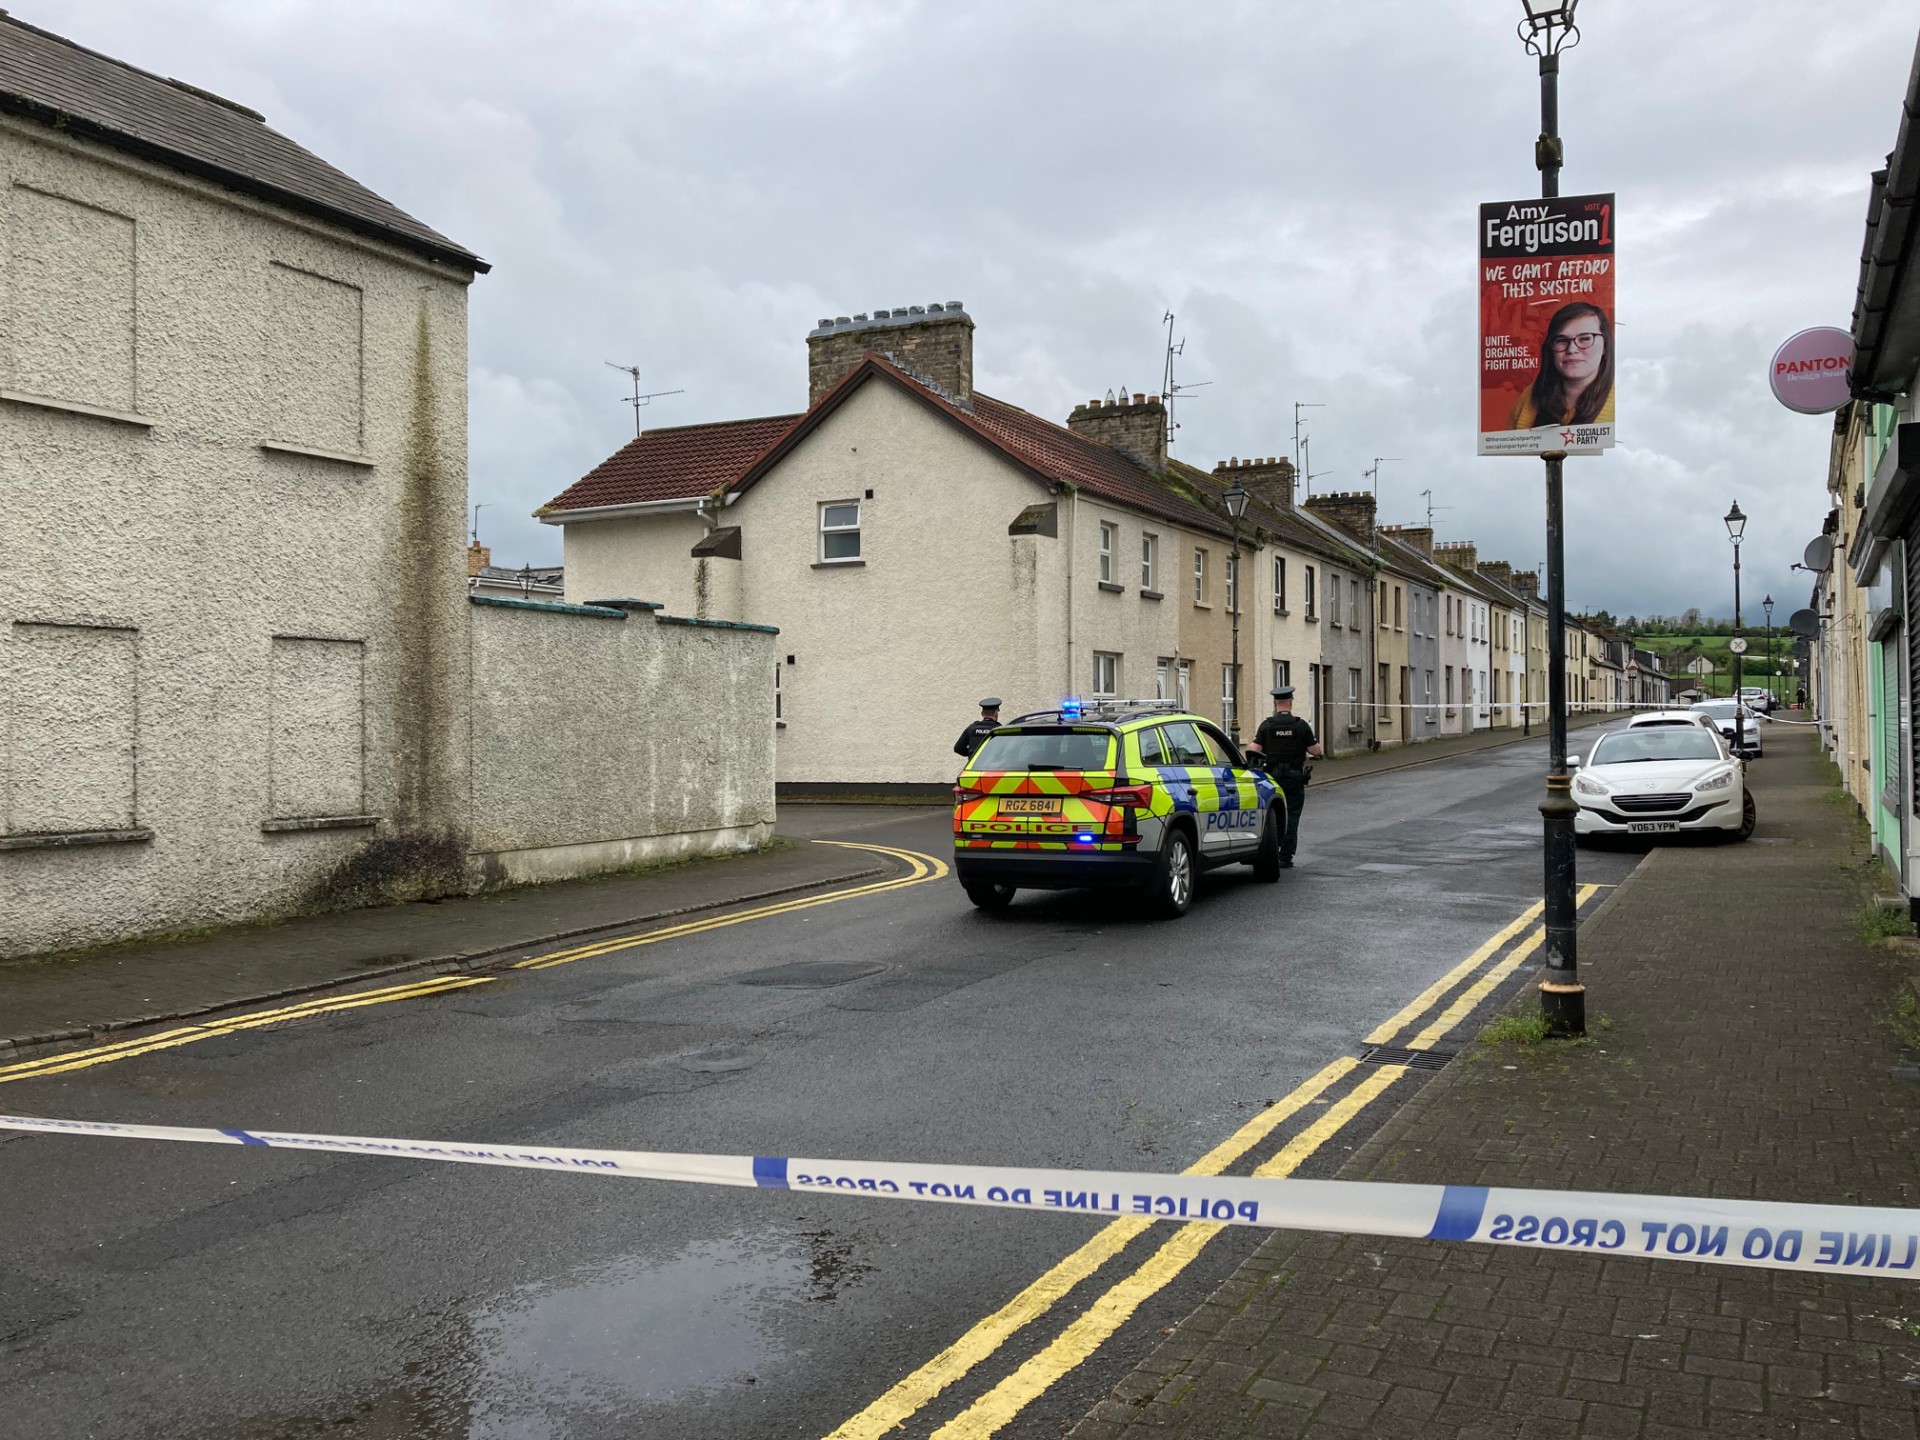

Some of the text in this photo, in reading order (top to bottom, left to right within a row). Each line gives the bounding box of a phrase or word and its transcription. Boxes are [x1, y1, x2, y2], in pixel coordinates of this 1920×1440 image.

[1506, 204, 1566, 223] Amy
[1599, 203, 1612, 246] 1
[1486, 218, 1598, 253] Ferguson
[1485, 265, 1507, 281] WE
[1558, 258, 1610, 278] AFFORD
[1502, 278, 1593, 298] THIS SYSTEM
[1485, 357, 1539, 370] FIGHT BACK!
[1576, 427, 1610, 437] SOCIALIST
[1576, 436, 1599, 445] PARTY
[1005, 800, 1055, 811] RGZ 6841
[969, 823, 1094, 833] POLICE
[1207, 811, 1257, 830] POLICE
[1657, 822, 1676, 831] YPM
